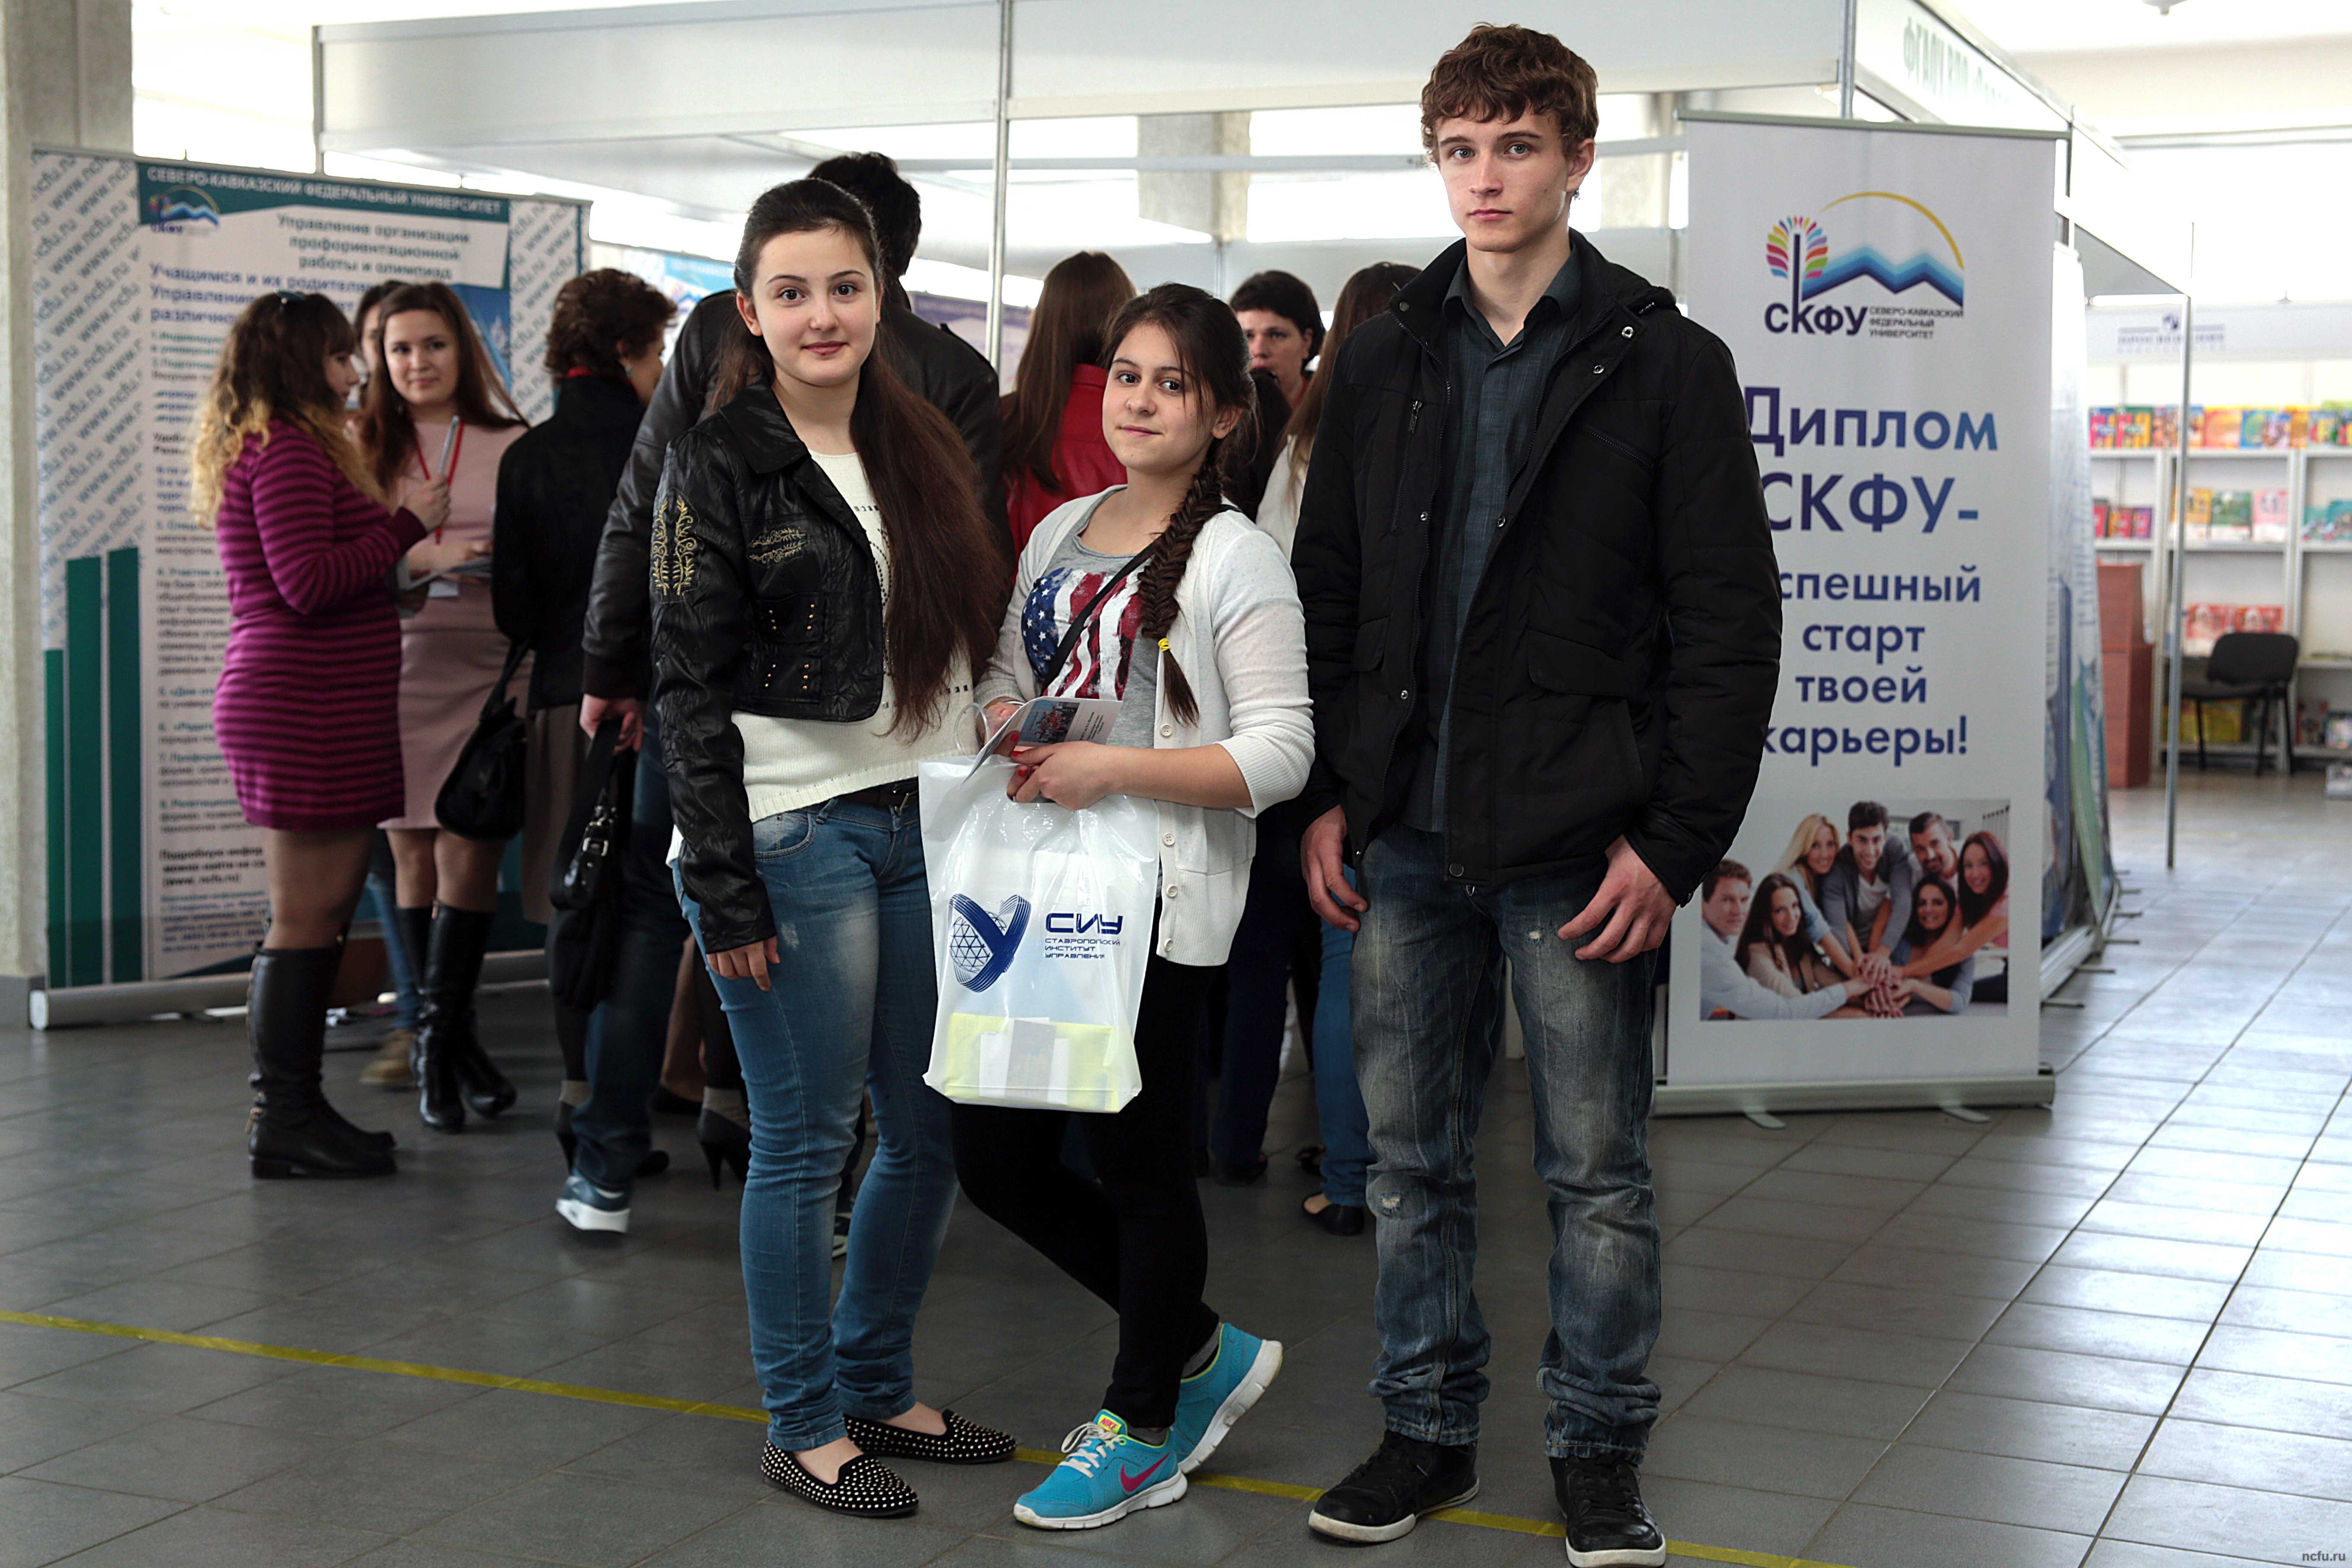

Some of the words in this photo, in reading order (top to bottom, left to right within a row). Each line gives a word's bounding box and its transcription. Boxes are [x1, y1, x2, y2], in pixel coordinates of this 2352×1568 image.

[147, 166, 302, 193] СЕВЕРО-КАВКАЗСКИЙ
[304, 182, 408, 205] ФЕДЕРАЛЬНЫЙ
[410, 193, 501, 214] УНИВЕРСИТЕТ
[277, 214, 370, 237] Управление
[375, 224, 470, 243] организации
[290, 237, 460, 259] профориентационной
[150, 262, 242, 284] Учащимся
[246, 274, 258, 284] и
[262, 274, 281, 287] их
[287, 277, 374, 292] родителя
[299, 255, 359, 270] работы
[362, 262, 372, 272] и
[375, 263, 453, 279] олимпиад
[1765, 302, 1868, 336] СКФУ
[1869, 306, 1963, 317] СЕВЕРО-КАВКАЗСКИЙ
[1869, 318, 1935, 327] ФЕДЕРАЛЬНЫЙ
[1869, 330, 1934, 339] УНИВЕРСИТЕТ
[1744, 387, 1998, 457] Диплом
[1779, 564, 1980, 602] спешный
[1802, 625, 1925, 665] старт
[1795, 665, 1926, 703] твоей
[1763, 714, 1967, 767] карьеры!
[1045, 913, 1123, 935] СИУ
[1100, 1418, 1117, 1429] NIKE
